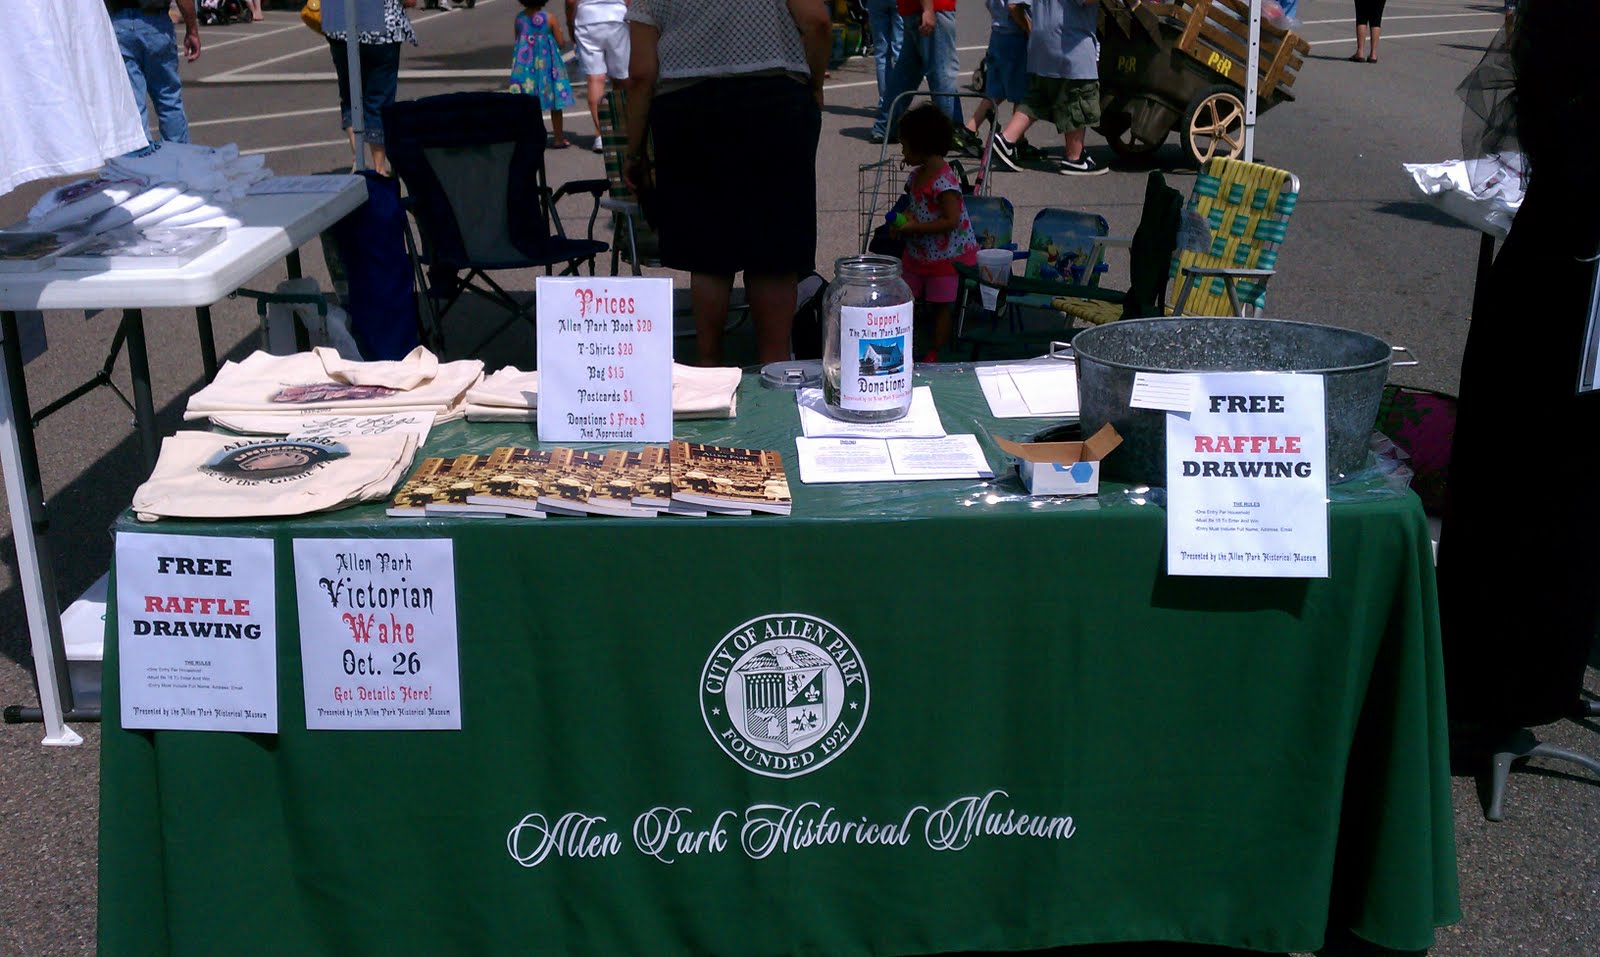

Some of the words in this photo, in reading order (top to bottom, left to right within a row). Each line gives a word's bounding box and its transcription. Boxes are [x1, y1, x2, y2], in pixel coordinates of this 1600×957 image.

[575, 288, 635, 318] Prices
[558, 319, 581, 334] Allen
[584, 319, 607, 333] Park
[611, 319, 634, 333] Book
[636, 319, 652, 333] $20
[867, 312, 900, 328] Support
[849, 328, 860, 338] The
[879, 328, 893, 338] Park
[578, 343, 615, 357] T-Shirts
[617, 343, 633, 356] $20
[587, 366, 606, 381] Bag
[608, 366, 624, 379] $15
[858, 376, 905, 395] Donations
[578, 389, 621, 404] Postcards
[623, 389, 633, 402] $1
[1209, 395, 1285, 413] FREE
[567, 412, 607, 427] Donations
[617, 413, 637, 427] Free
[580, 428, 594, 439] And
[595, 429, 633, 440] Appreciated
[224, 437, 287, 452] ALLEN
[1194, 435, 1301, 454] RAFFLE
[702, 451, 726, 459] ALLEN
[1183, 460, 1312, 478] DRAWING
[157, 556, 232, 576] FREE
[335, 553, 372, 574] Allen
[376, 552, 412, 573] Park
[1180, 551, 1208, 562] Presented
[1210, 552, 1217, 562] by
[1218, 551, 1227, 561] the
[1228, 552, 1244, 562] Allen
[1245, 552, 1261, 562] Park
[1262, 552, 1292, 562] Historical
[1293, 553, 1317, 563] Museum
[319, 577, 434, 615] Victorian
[144, 595, 250, 616] RAFFLE
[133, 620, 262, 640] DRAWING
[342, 612, 415, 644] Wake
[343, 649, 381, 676] Oct.
[392, 651, 421, 675] 26
[705, 646, 736, 694] CITY
[733, 627, 757, 651] OF
[764, 619, 829, 645] ALLEN
[826, 637, 863, 687] PARK
[334, 686, 353, 704] Get
[357, 686, 395, 701] Details
[400, 686, 432, 703] Here!
[133, 707, 161, 717] Presented
[163, 708, 169, 717] by
[170, 707, 179, 716] the
[180, 707, 196, 717] Allen
[197, 708, 212, 717] Park
[215, 709, 243, 718] Historical
[244, 710, 267, 719] Museum
[318, 708, 345, 717] Presented
[346, 708, 353, 718] by
[354, 708, 363, 716] the
[364, 708, 380, 717] Allen
[381, 708, 396, 717] Park
[398, 708, 426, 717] Historical
[428, 708, 450, 717] Museum
[721, 728, 815, 770] FOUNDED
[819, 721, 850, 755] 1927
[507, 812, 622, 868] Allen
[633, 806, 738, 865] Park
[740, 801, 930, 860] Historical
[925, 790, 1077, 852] Museum
